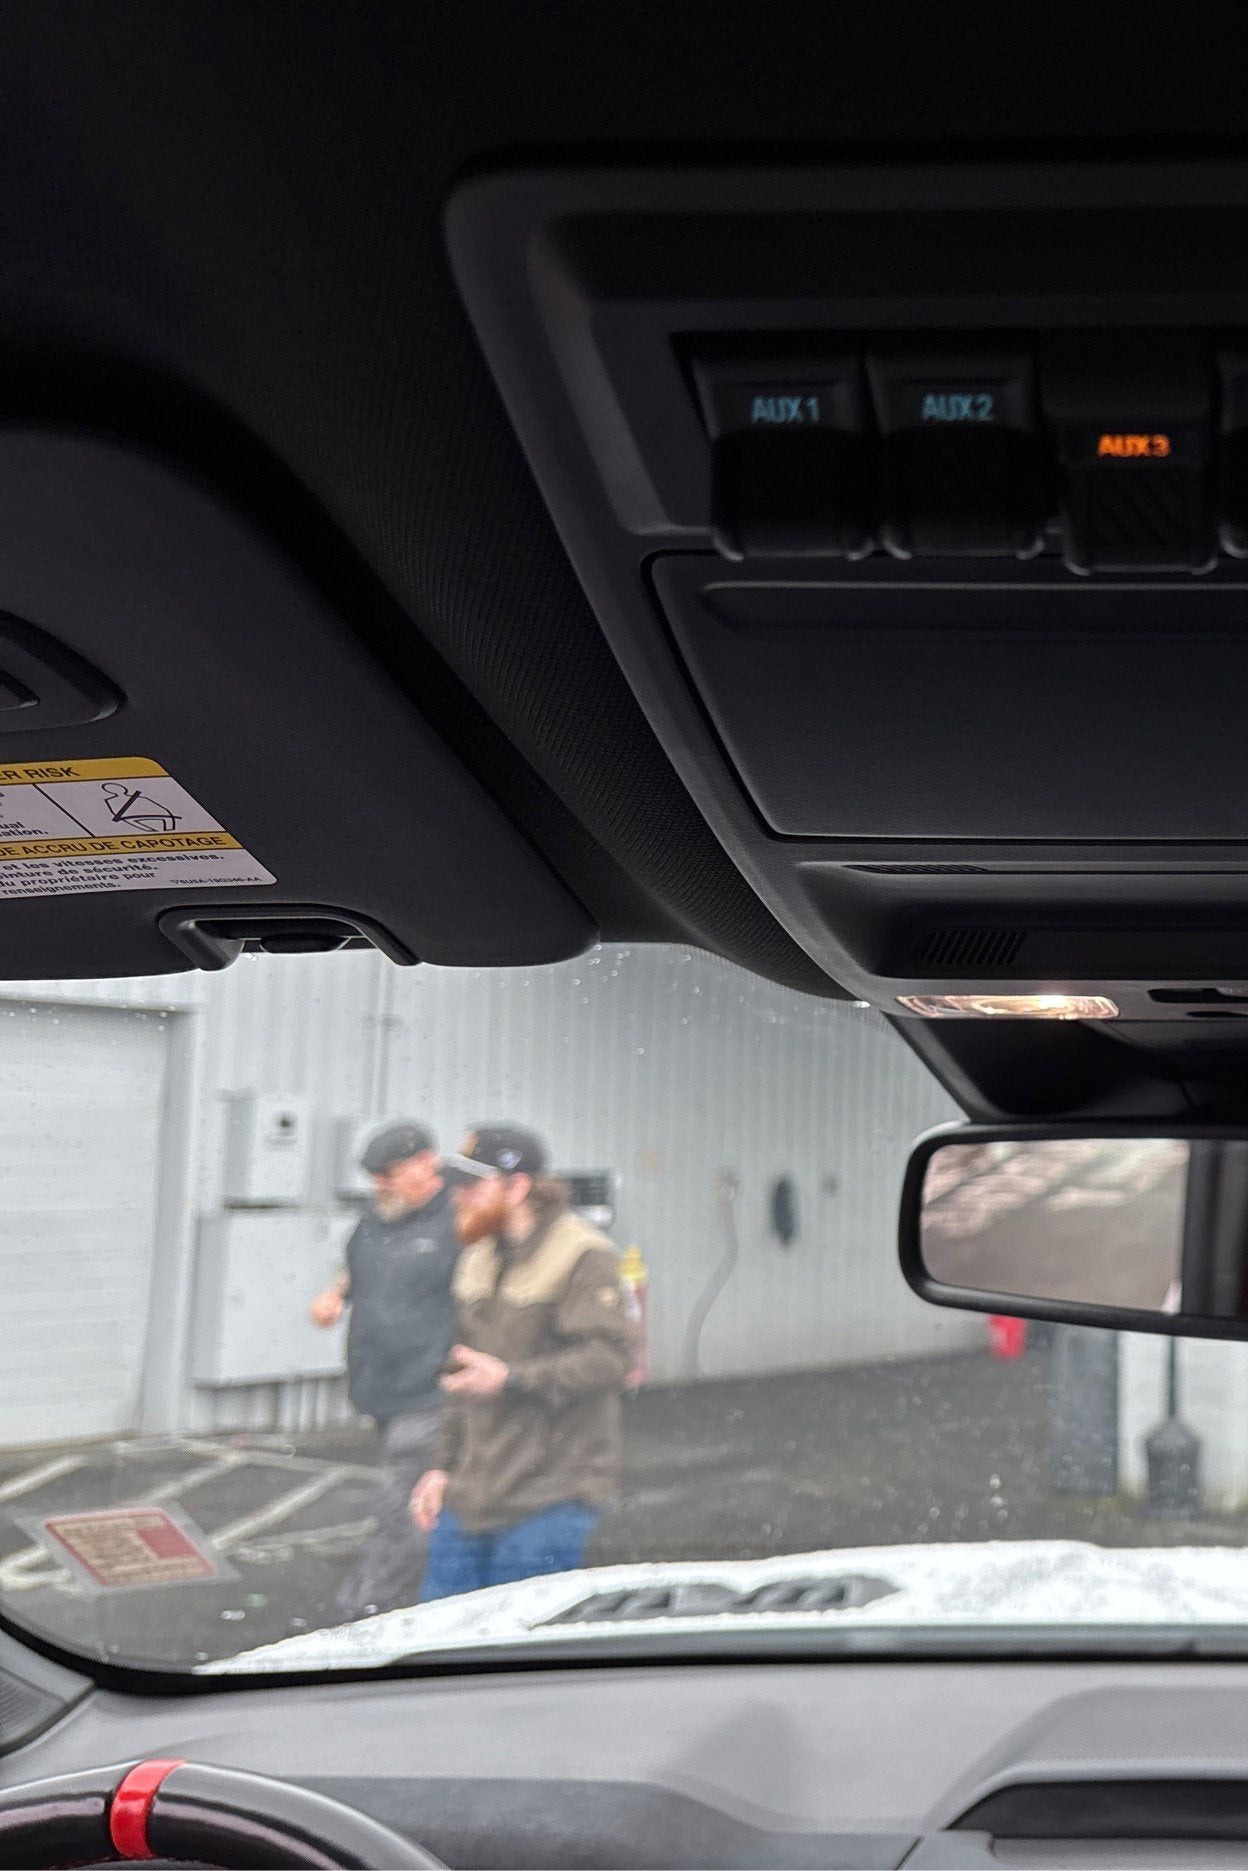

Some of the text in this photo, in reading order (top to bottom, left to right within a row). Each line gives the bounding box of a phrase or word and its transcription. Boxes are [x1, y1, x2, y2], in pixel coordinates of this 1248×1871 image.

[23, 766, 81, 779] RISK
[0, 829, 49, 837] ation.
[21, 842, 88, 855] ACCRU
[89, 841, 120, 851] DE
[120, 836, 227, 849] CAPOTAGE
[22, 862, 50, 870] les
[53, 858, 123, 868] vitesses
[127, 853, 225, 863] excessives.
[58, 868, 80, 876] de
[82, 864, 159, 874] sécurité.
[20, 874, 120, 887] propriétaire
[122, 872, 155, 880] pour
[2, 881, 122, 895] renseignements.
